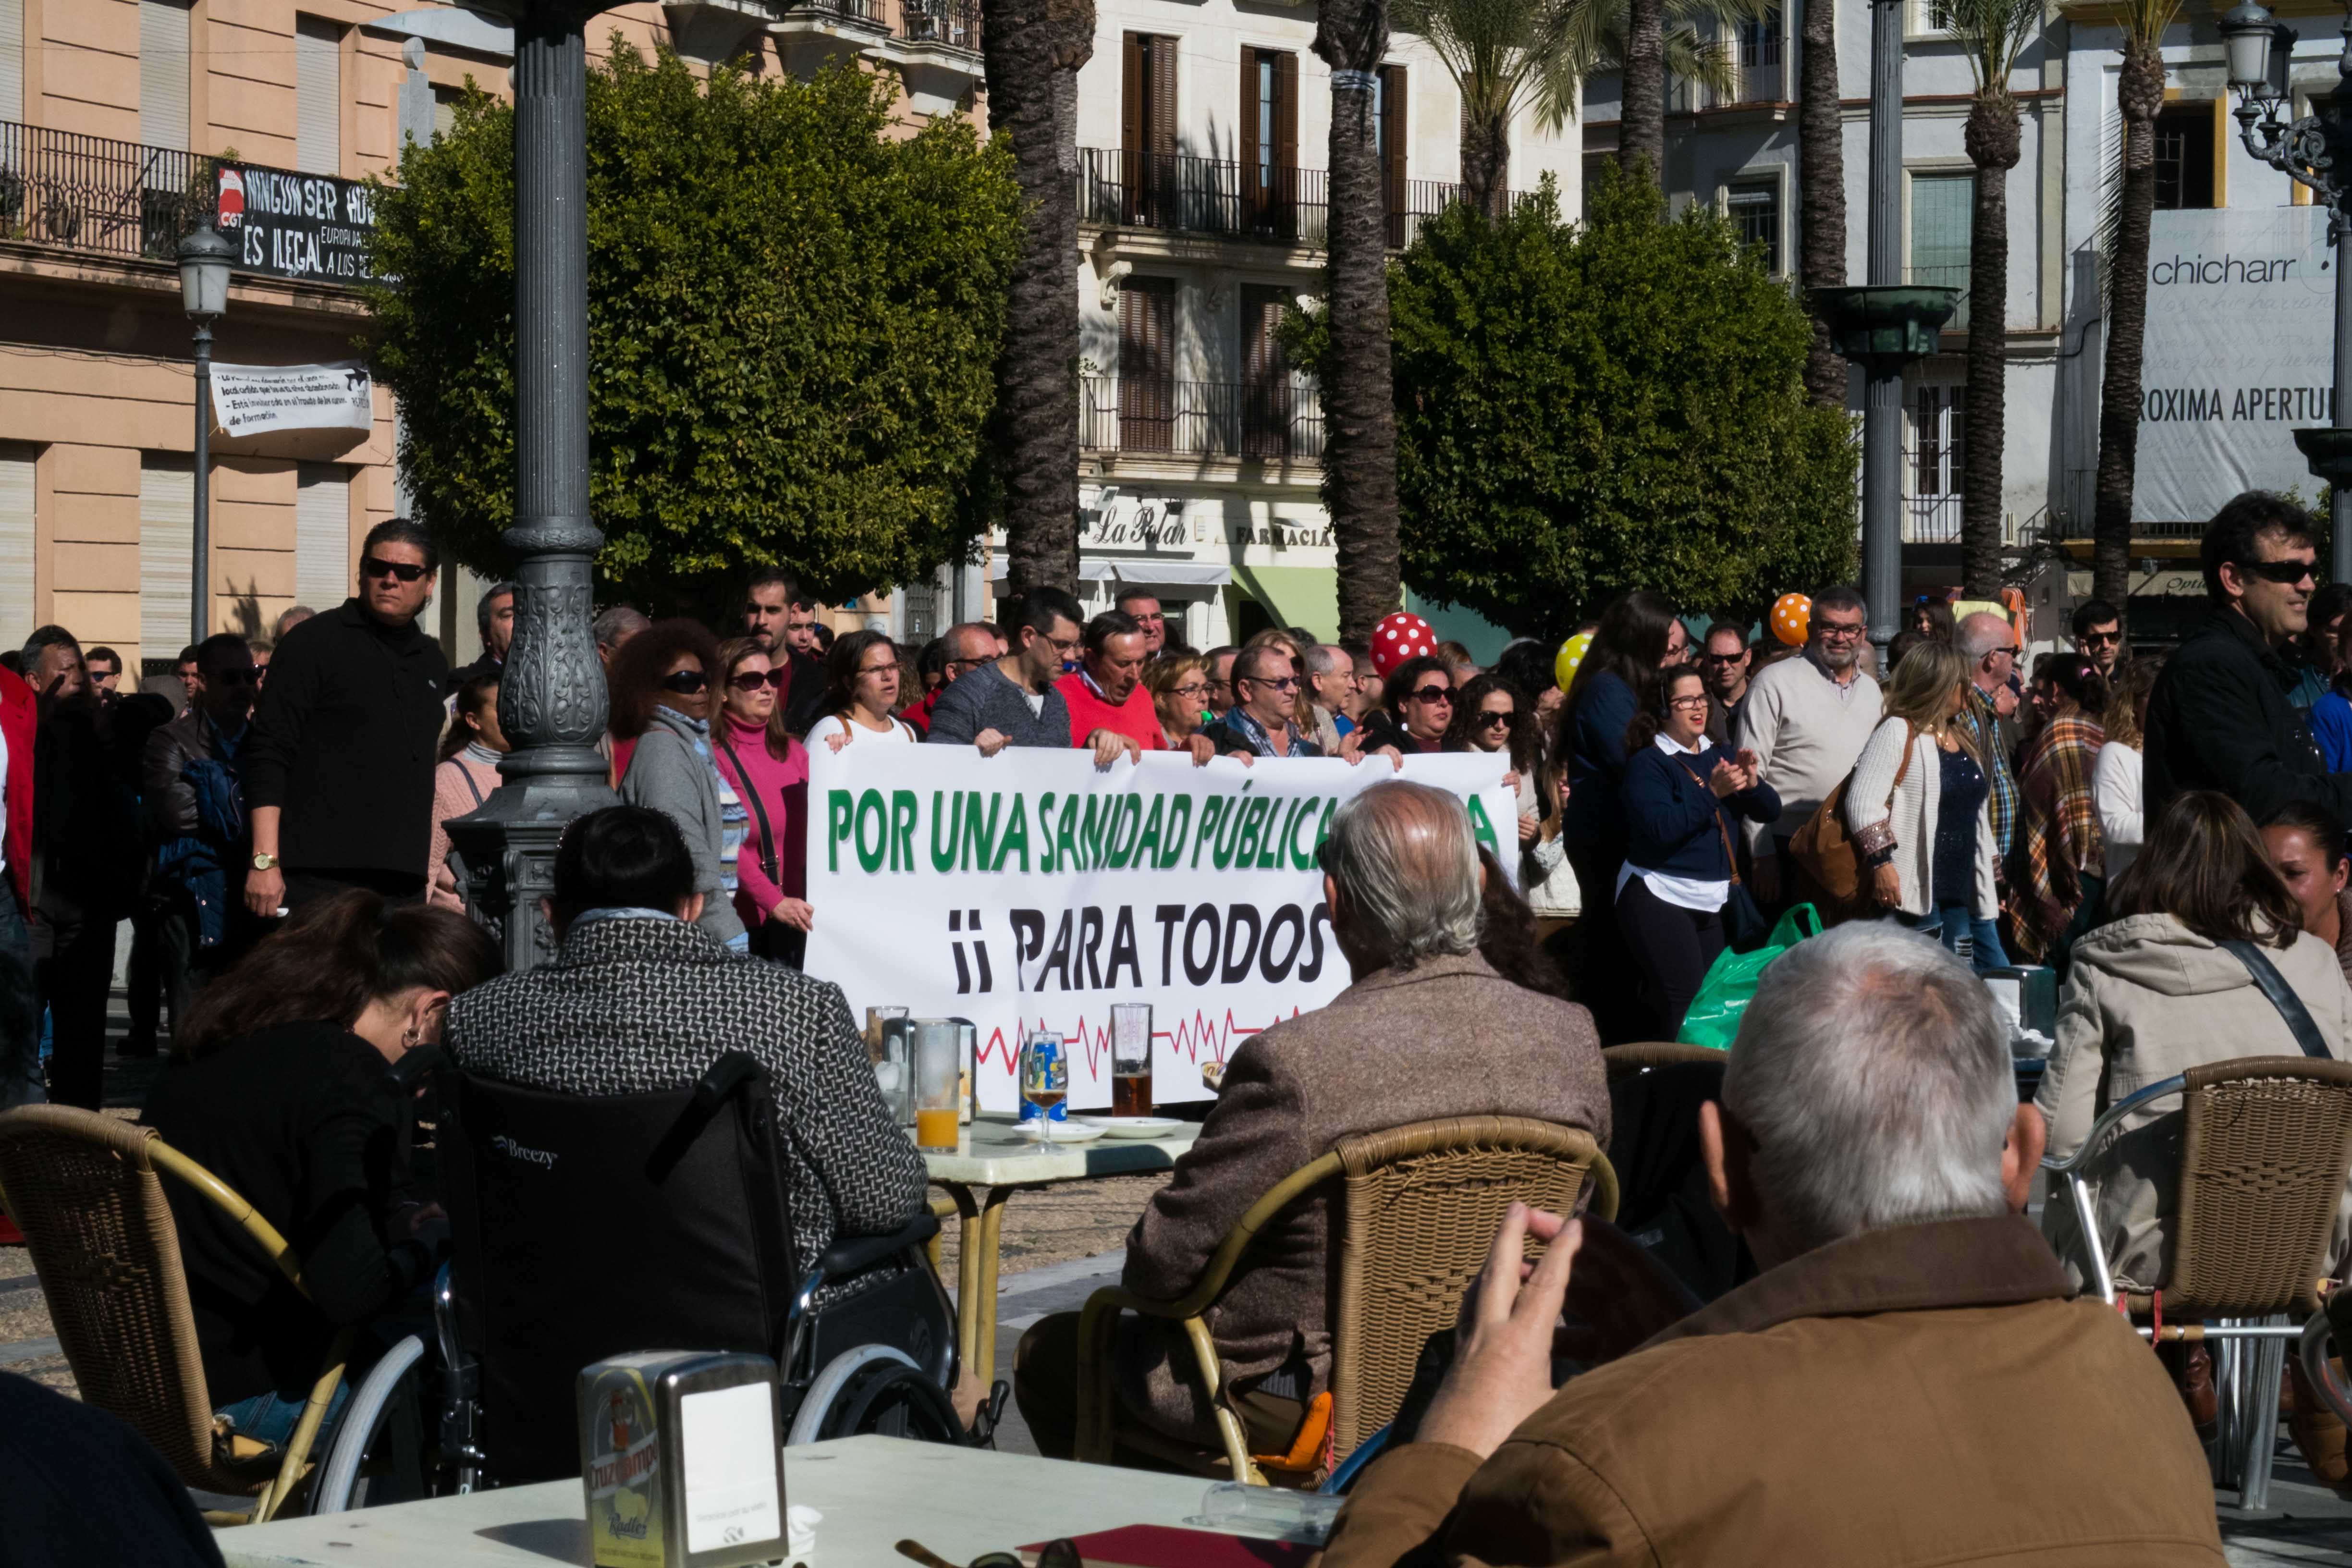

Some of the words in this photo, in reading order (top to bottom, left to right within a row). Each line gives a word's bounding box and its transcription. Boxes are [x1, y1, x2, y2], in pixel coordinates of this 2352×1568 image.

[245, 170, 302, 216] NINGUN
[304, 180, 337, 220] SER
[221, 212, 243, 228] CGT
[244, 225, 264, 266] ES
[273, 228, 323, 273] ILEGAL
[321, 226, 350, 246] EUROPA
[327, 252, 334, 274] A
[337, 252, 355, 276] LOS
[230, 416, 241, 425] de
[1093, 505, 1127, 544] La
[1130, 506, 1188, 545] Polar
[1236, 527, 1331, 546] FARMACIA
[828, 788, 918, 874] POR
[931, 790, 1029, 873] UNA
[1039, 791, 1192, 873] SANIDAD
[1190, 780, 1338, 870] PÚBLICA
[1010, 905, 1143, 992] PARA
[1155, 902, 1331, 987] TODOS
[508, 1138, 553, 1170] Breezy
[608, 1513, 647, 1540] Radler
